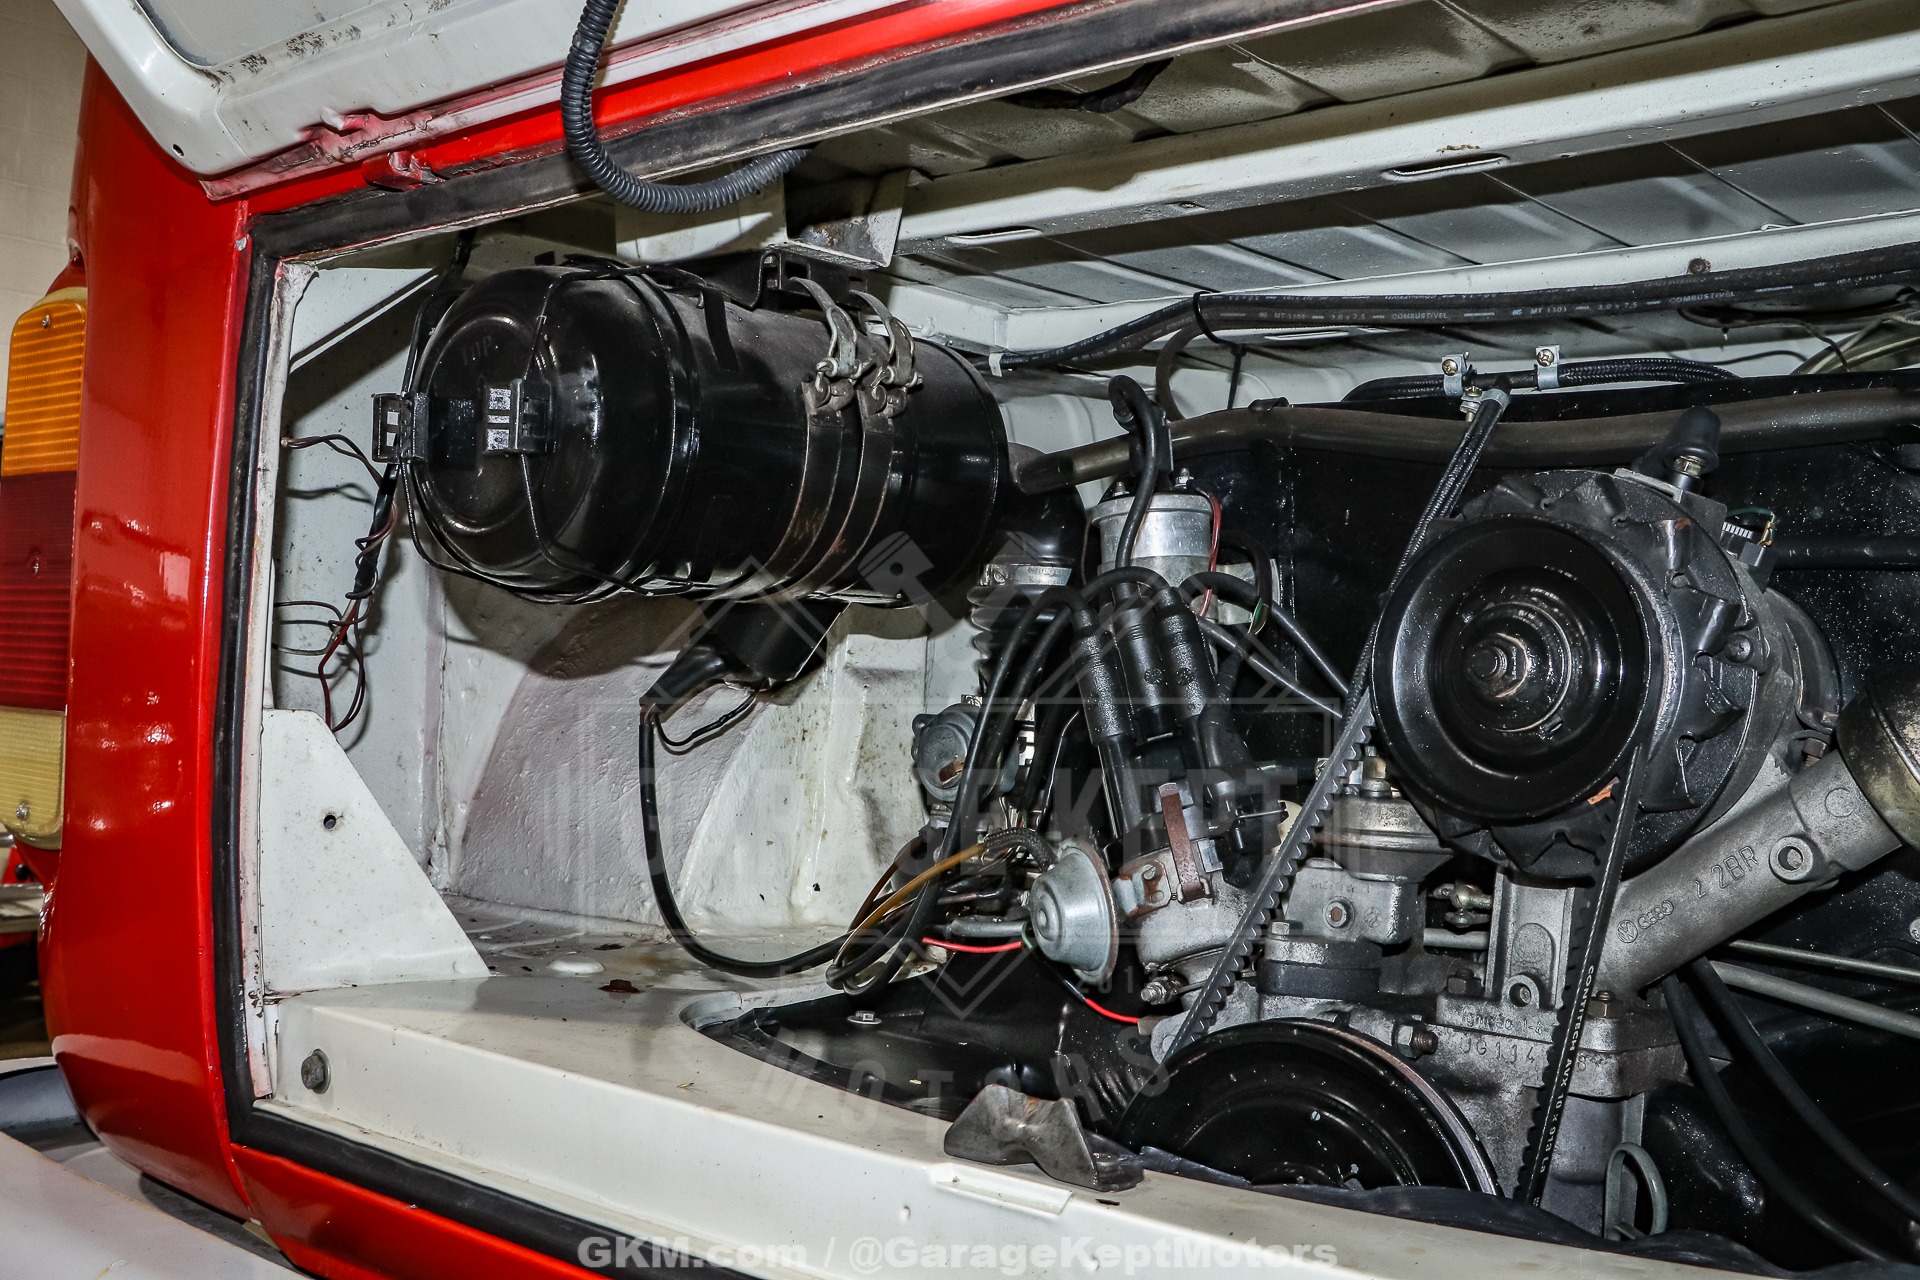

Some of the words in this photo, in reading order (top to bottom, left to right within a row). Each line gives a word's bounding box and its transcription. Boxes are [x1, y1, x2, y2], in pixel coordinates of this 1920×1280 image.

[1569, 964, 1595, 1052] CONTITECH
[1560, 1057, 1573, 1087] AVX
[1555, 1092, 1565, 1110] 10
